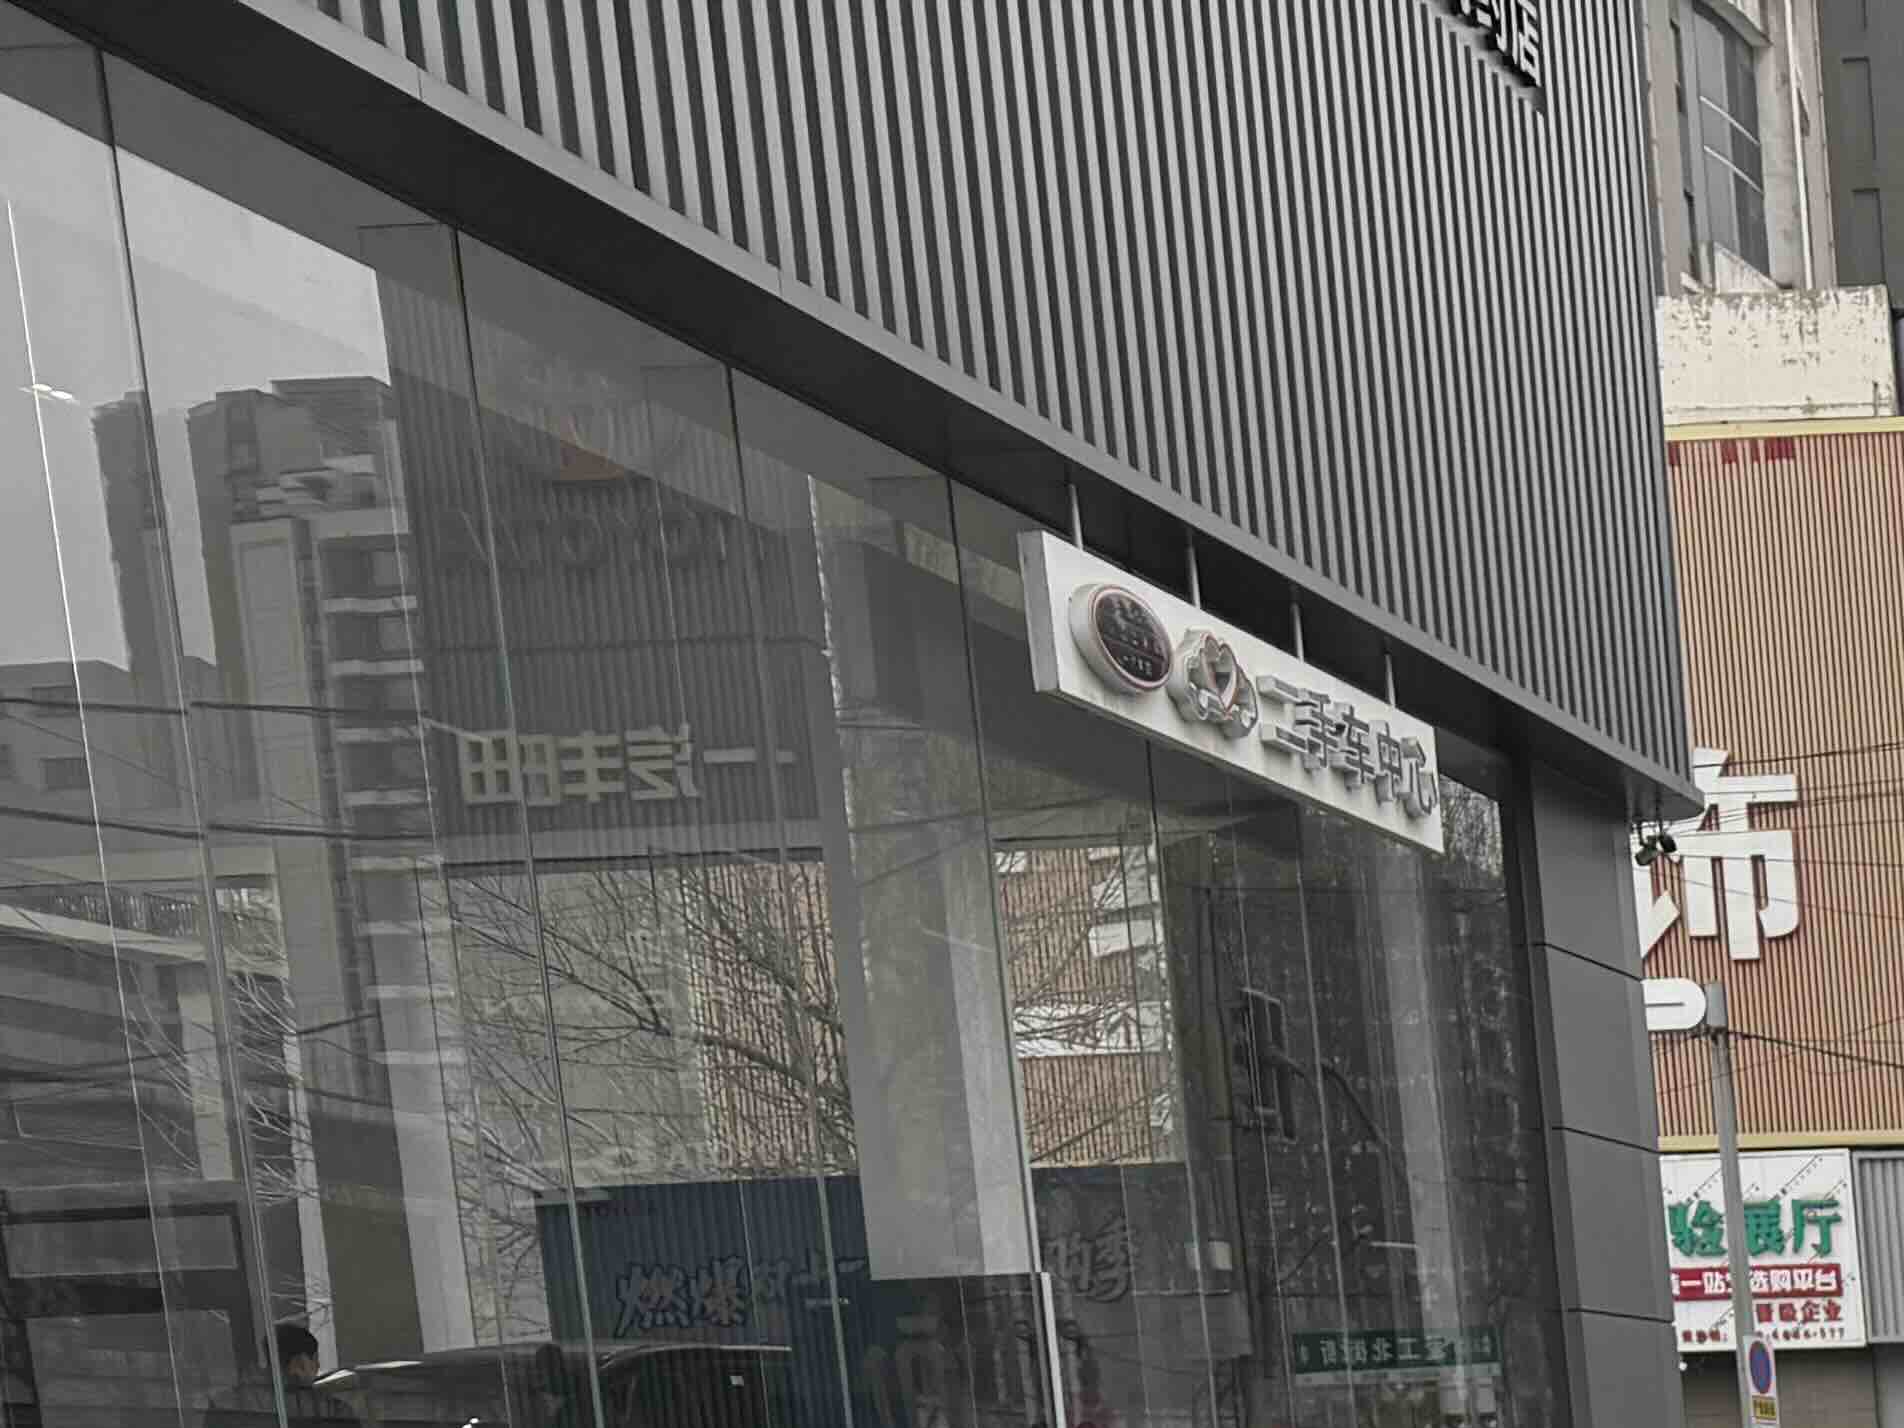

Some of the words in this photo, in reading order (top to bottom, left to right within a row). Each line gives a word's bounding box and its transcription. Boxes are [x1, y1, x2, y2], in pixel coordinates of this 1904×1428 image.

[1257, 674, 1439, 818] 二手车中心
